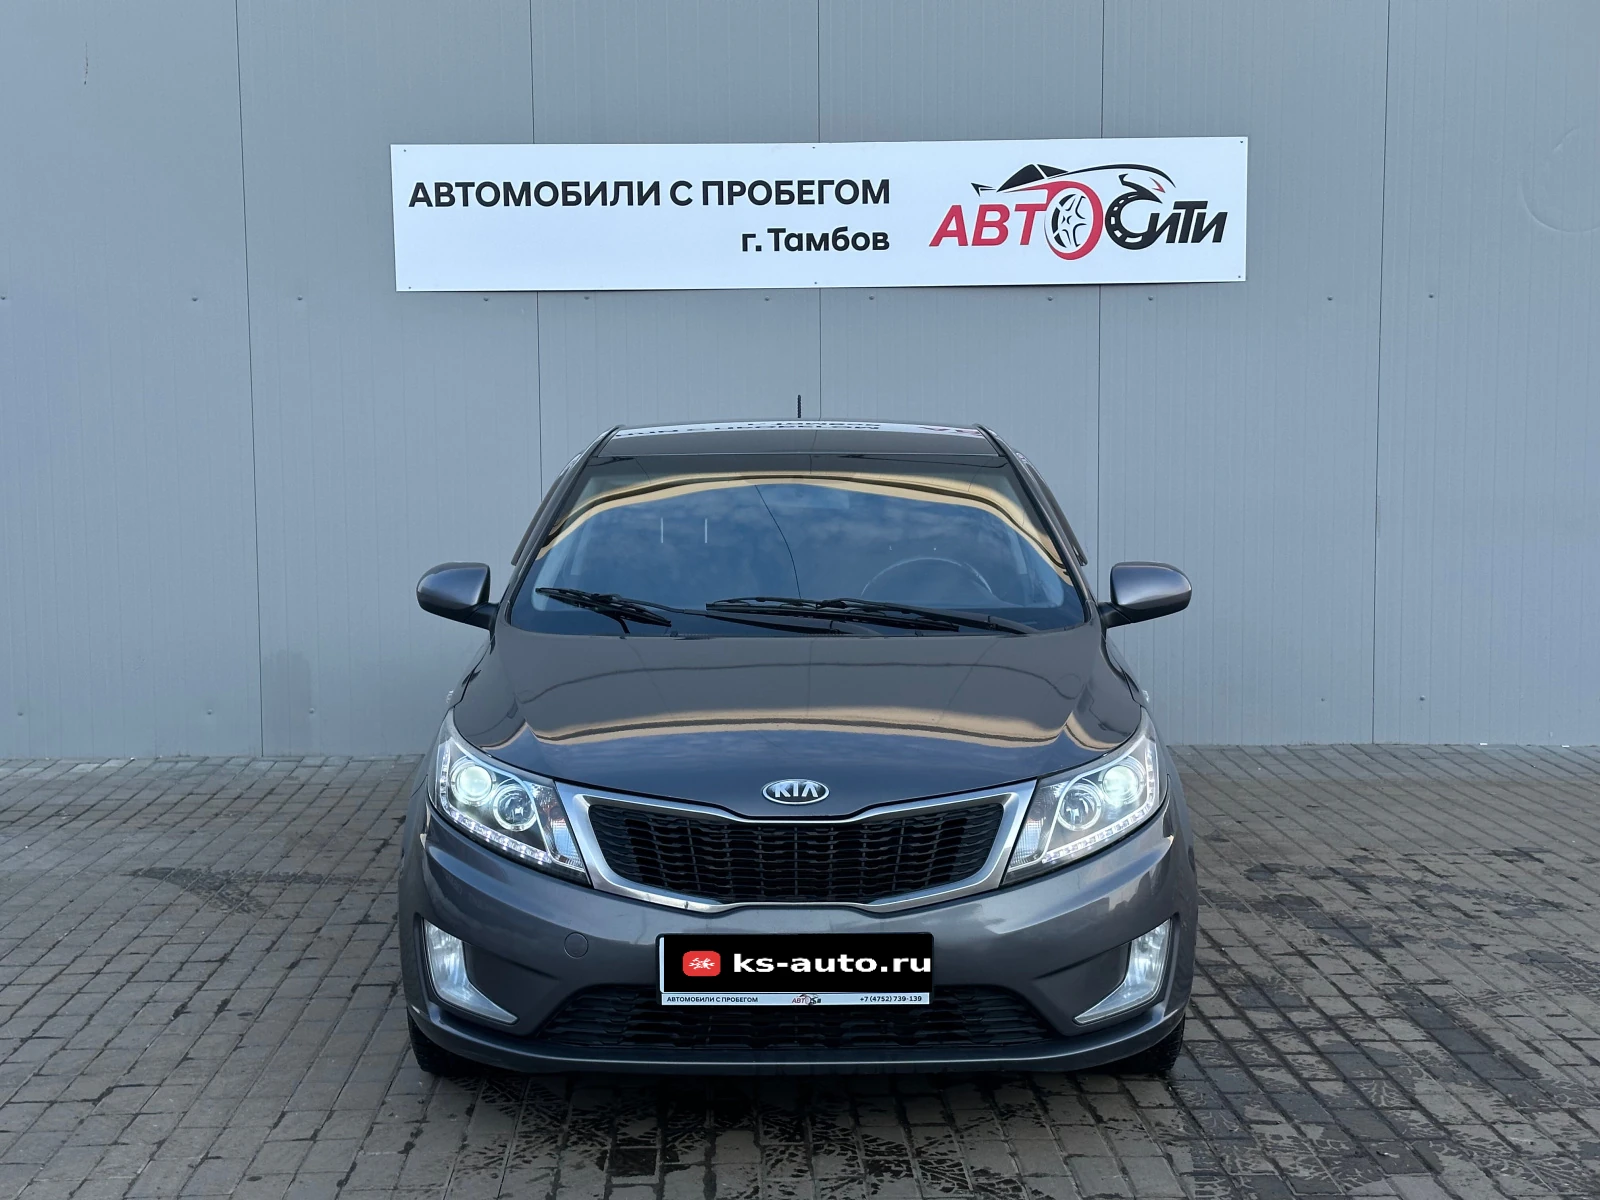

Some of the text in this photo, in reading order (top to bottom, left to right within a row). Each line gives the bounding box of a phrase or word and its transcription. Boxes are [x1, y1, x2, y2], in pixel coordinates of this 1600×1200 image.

[408, 178, 890, 208] АВТОМОБИЛИ С ПРОБЕГОМ
[741, 226, 890, 252] г. Тамбов
[773, 781, 819, 798] KIA
[869, 995, 892, 1003] (4752)
